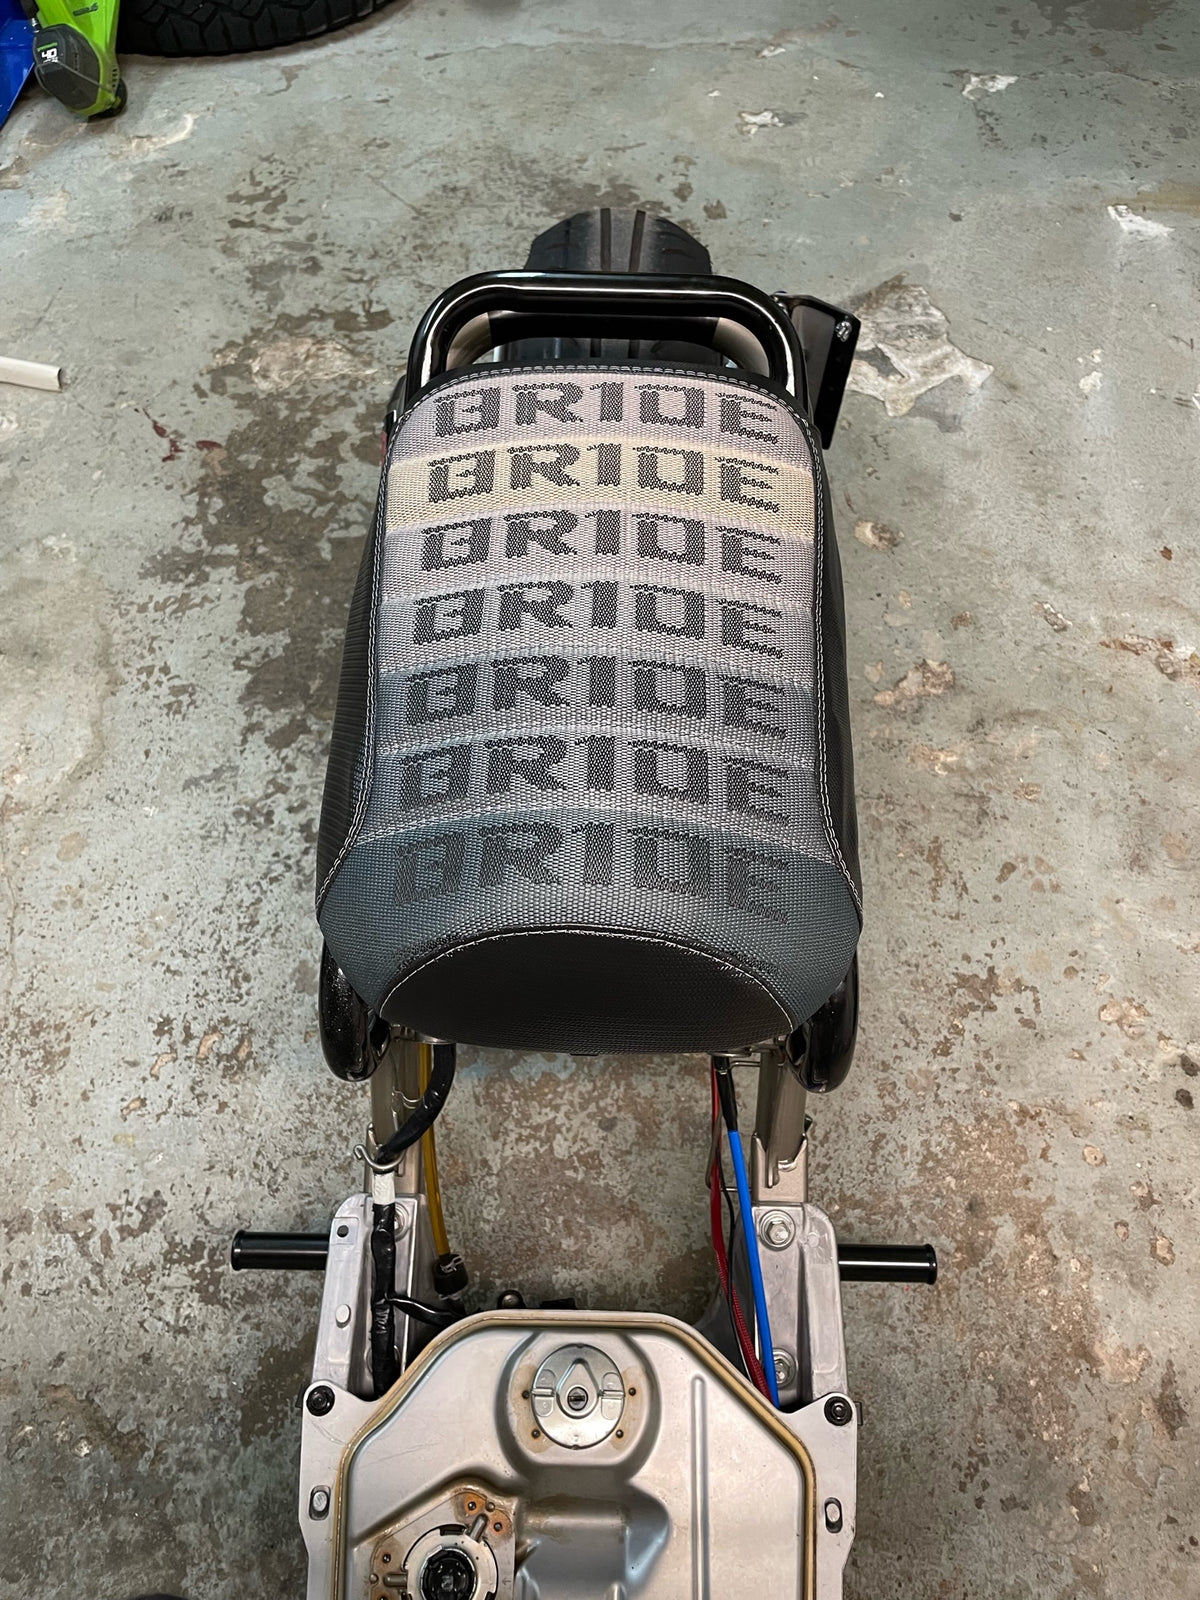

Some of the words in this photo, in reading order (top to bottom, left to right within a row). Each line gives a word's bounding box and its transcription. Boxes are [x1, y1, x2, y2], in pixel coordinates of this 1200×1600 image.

[434, 381, 779, 444] BRIDE
[428, 443, 780, 513] BRIDE
[421, 509, 783, 584] BRIDE
[413, 580, 784, 658] BRIDE
[405, 655, 787, 738] BRIDE
[401, 734, 789, 825] BRIDE
[396, 822, 790, 923] BRIDE
